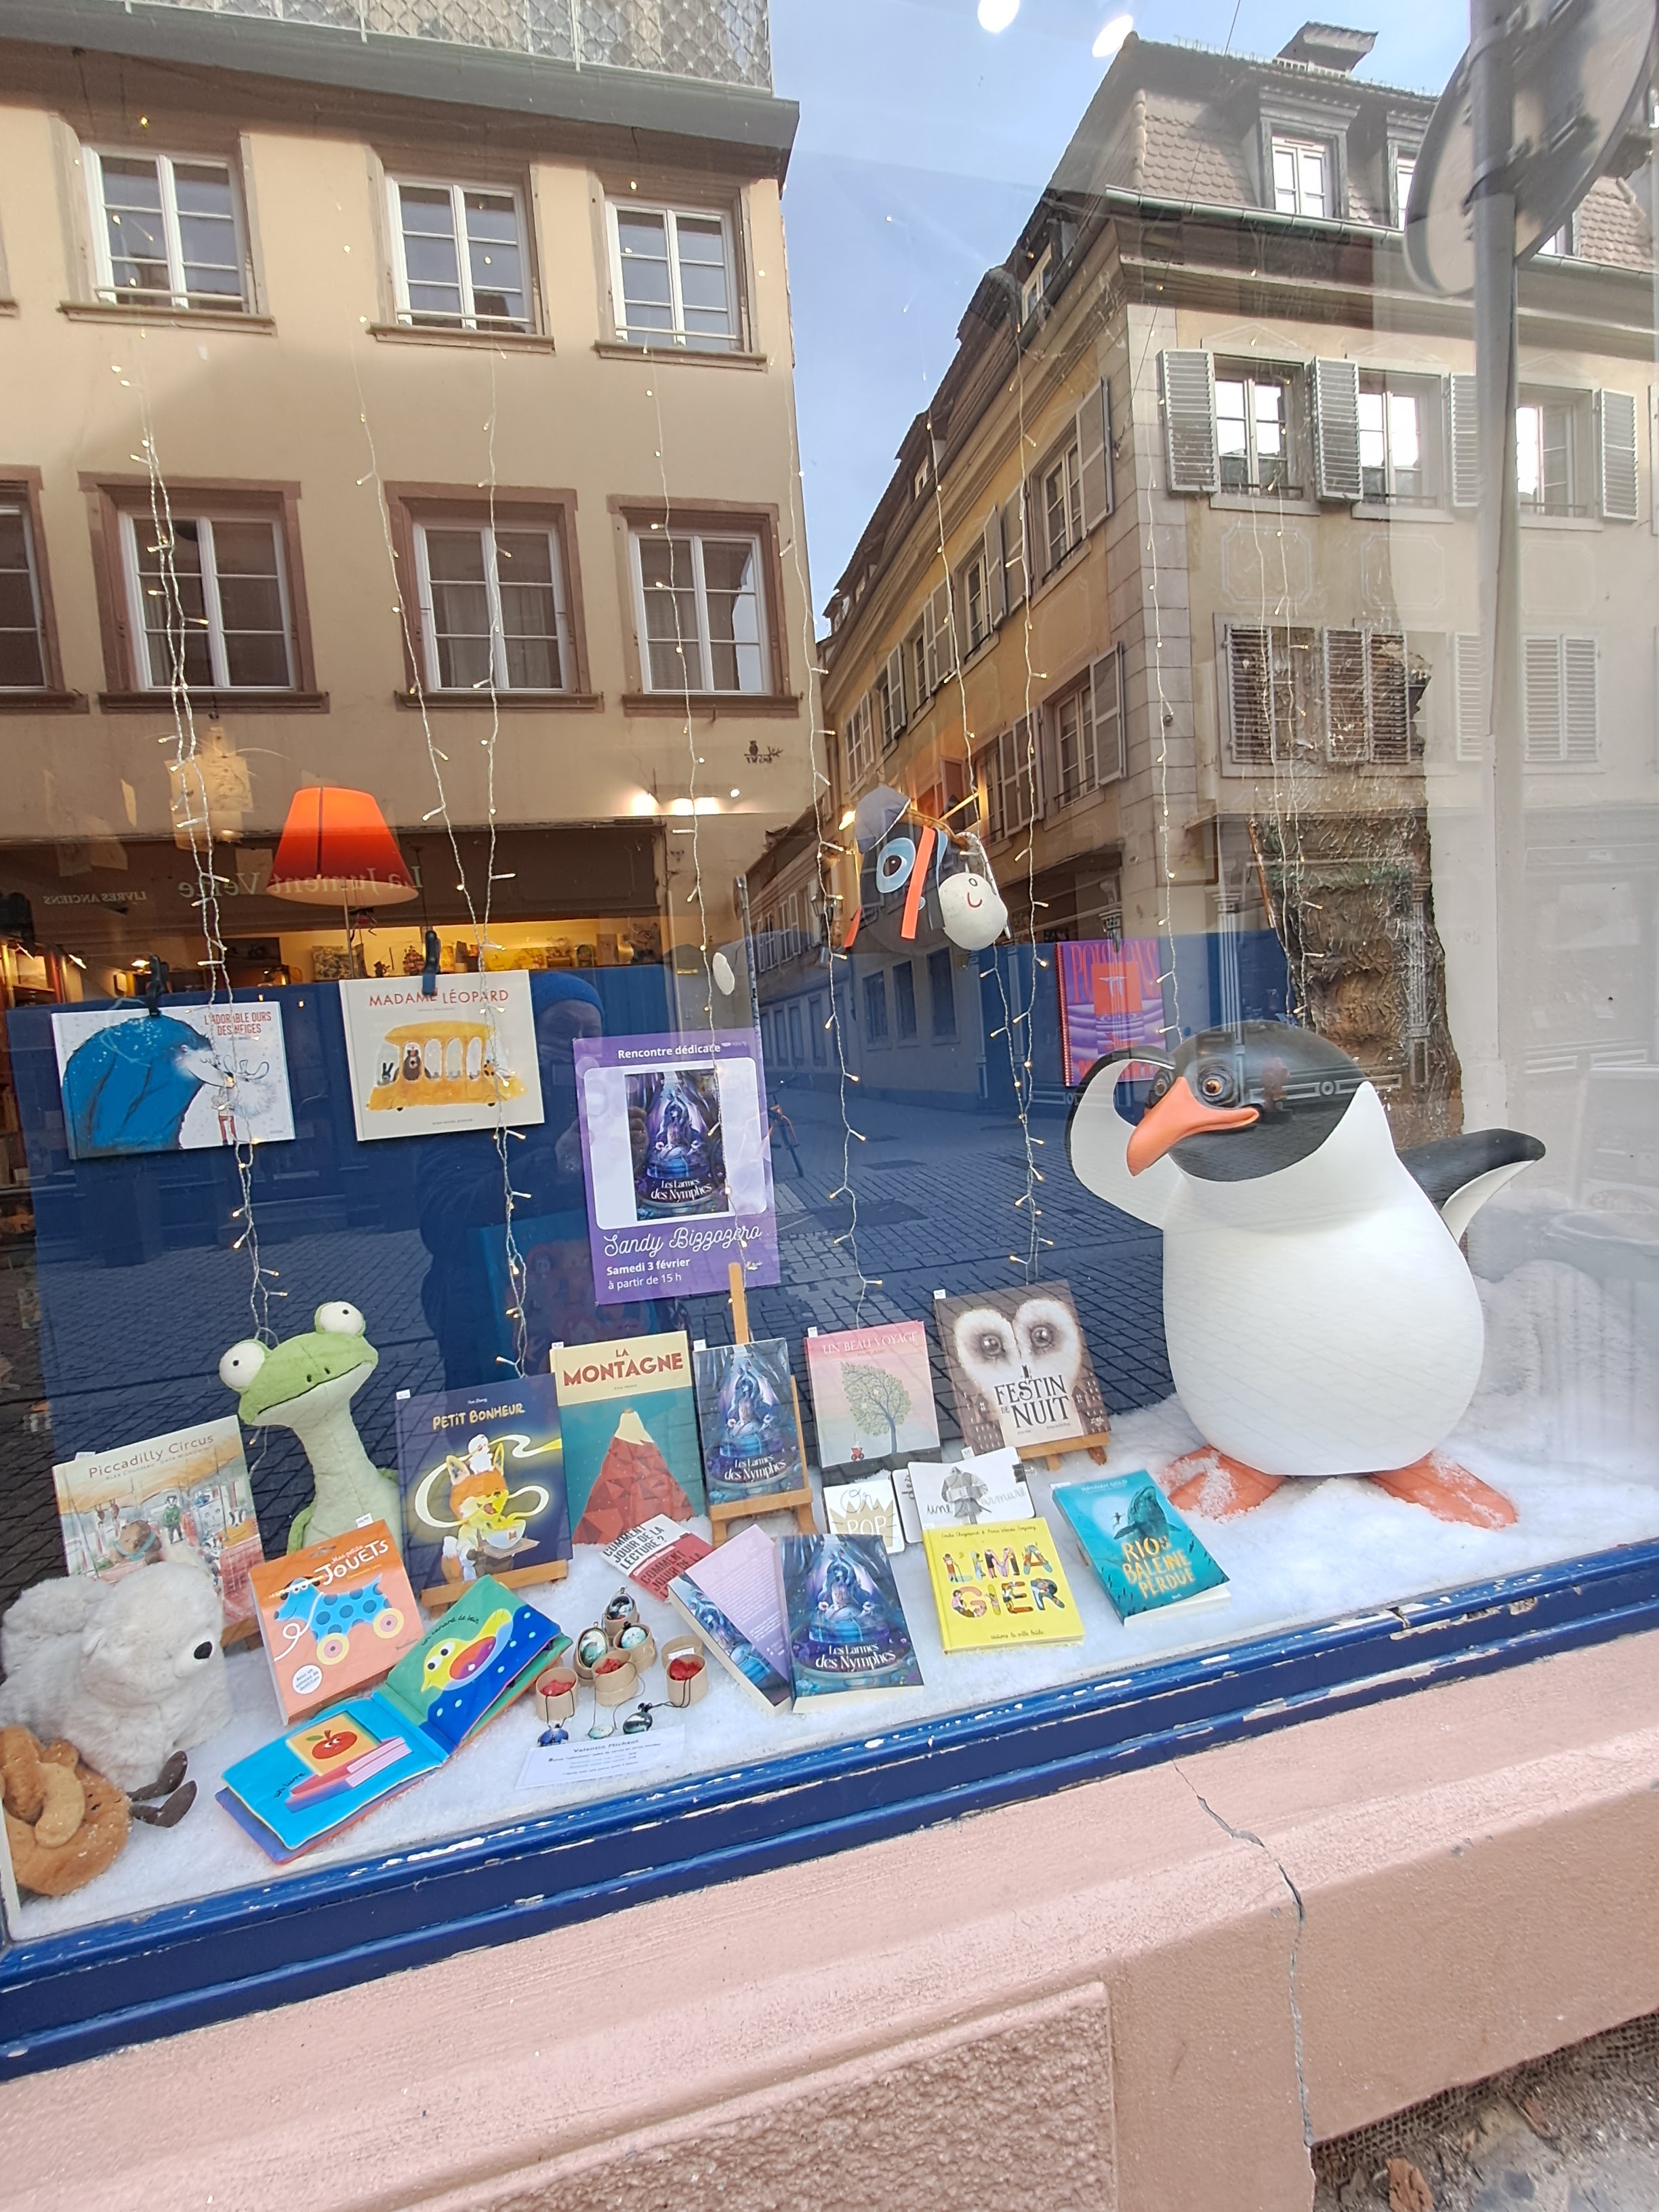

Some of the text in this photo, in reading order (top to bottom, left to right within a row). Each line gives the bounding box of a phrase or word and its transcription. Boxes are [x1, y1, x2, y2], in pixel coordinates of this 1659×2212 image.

[443, 989, 509, 1004] LÉOPARD
[251, 1011, 272, 1022] OURS
[217, 1023, 262, 1036] DES NEIGES
[617, 1047, 672, 1059] Rencontre
[675, 1044, 721, 1055] dédicace
[651, 1183, 712, 1202] des Nymphes
[603, 1225, 762, 1257] Sandy Bizzozero
[607, 1258, 691, 1275] Samedi 3 février
[608, 1273, 682, 1290] à partir de 15 h
[615, 1349, 629, 1357] LA
[823, 1332, 917, 1355] UN BEAU VOYAGE
[563, 1352, 683, 1387] MONTAGNE
[994, 1374, 1067, 1406] FESTIN
[469, 1403, 525, 1423] BONHEUR
[1001, 1406, 1010, 1414] DE
[1011, 1395, 1069, 1429] NUIT
[89, 1435, 214, 1478] Piccadilly Circus
[724, 1459, 786, 1483] des Nymphes
[926, 1486, 1025, 1515] une armure
[847, 1515, 886, 1535] POP
[602, 1524, 647, 1557] COMMENT
[613, 1538, 640, 1563] JOUIR
[640, 1531, 652, 1544] DE
[649, 1525, 665, 1537] LA
[1122, 1537, 1161, 1564] RIO
[314, 1539, 389, 1586] JOUETS
[620, 1540, 661, 1570] LECTURE
[640, 1550, 685, 1584] COMMENT
[1122, 1549, 1191, 1584] BALEINE
[651, 1565, 678, 1591] JOUIR
[1138, 1568, 1195, 1600] PERDUE
[951, 1578, 1065, 1618] GIER
[432, 1617, 456, 1635] canard
[815, 1649, 896, 1673] des Nymphes
[573, 1744, 606, 1753] Valentin
[282, 1773, 305, 1786] livre
